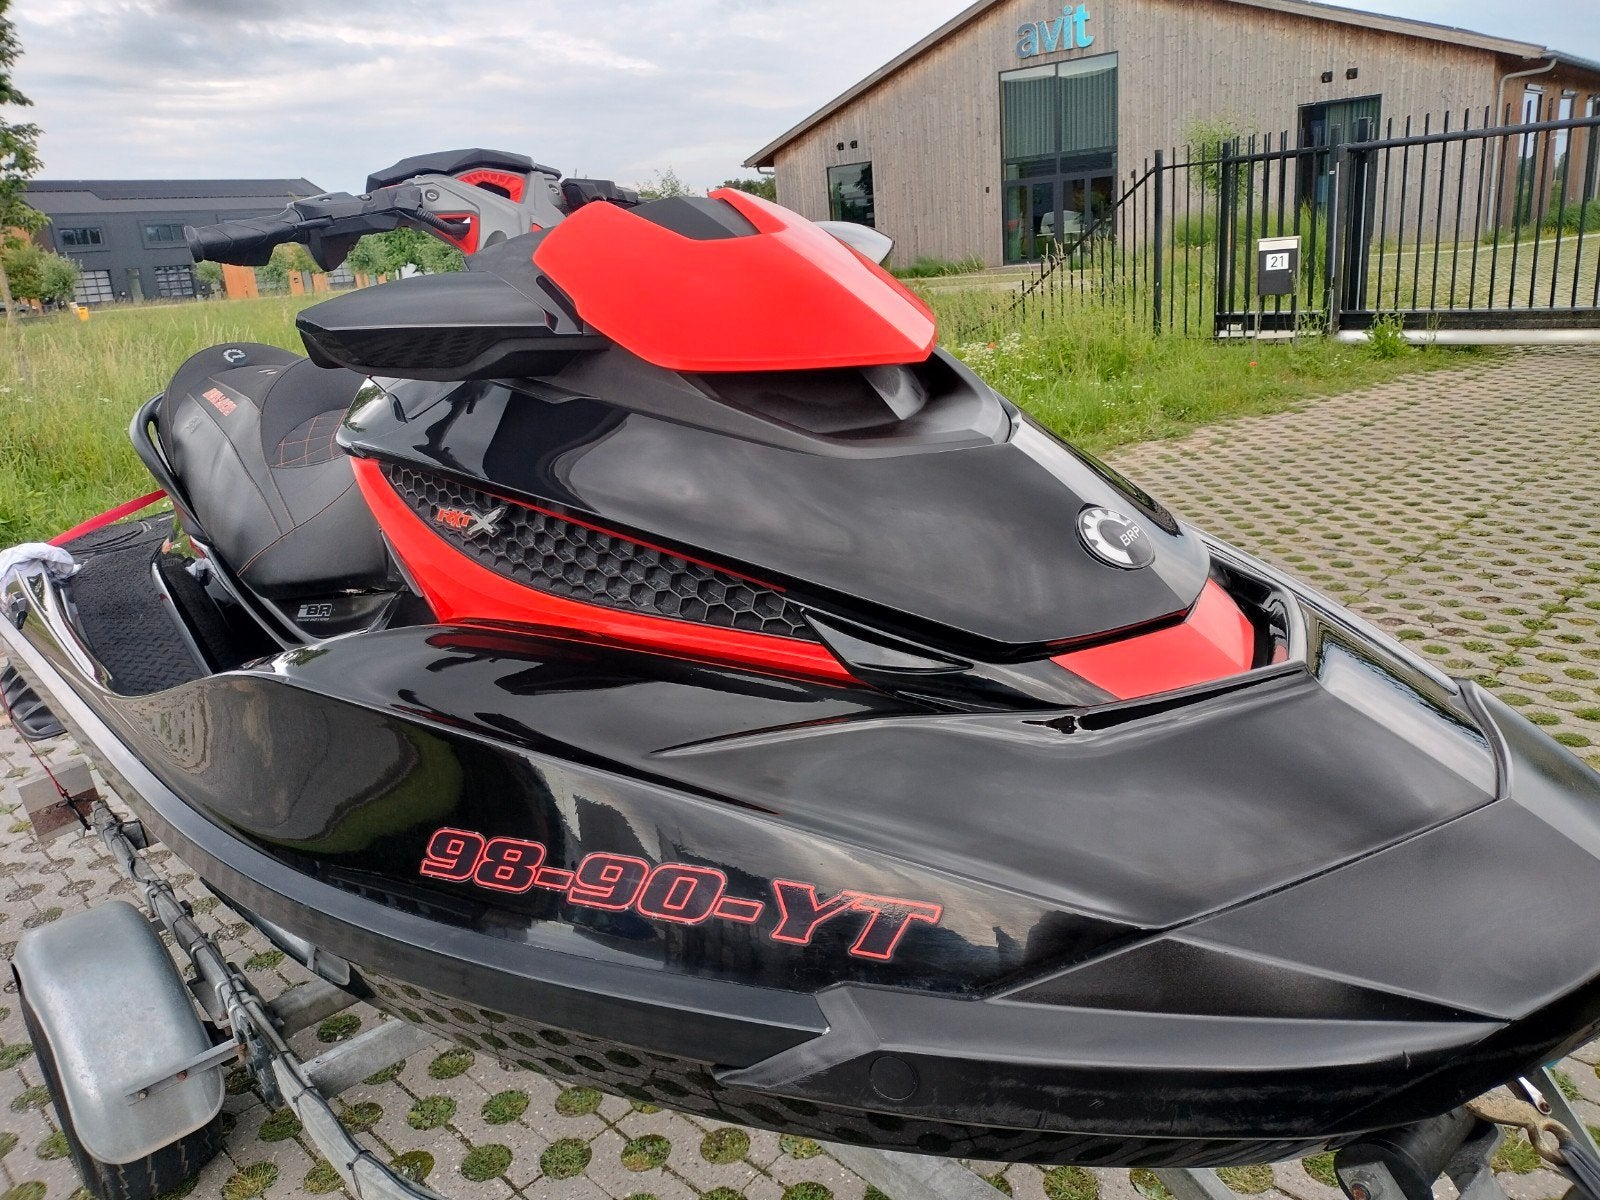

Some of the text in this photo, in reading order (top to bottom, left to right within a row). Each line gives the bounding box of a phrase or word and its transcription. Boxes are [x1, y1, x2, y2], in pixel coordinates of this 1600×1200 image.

[1015, 4, 1094, 59] avit
[1271, 255, 1284, 268] 21
[1119, 525, 1140, 547] BRP
[420, 827, 944, 960] 98-90-YT
